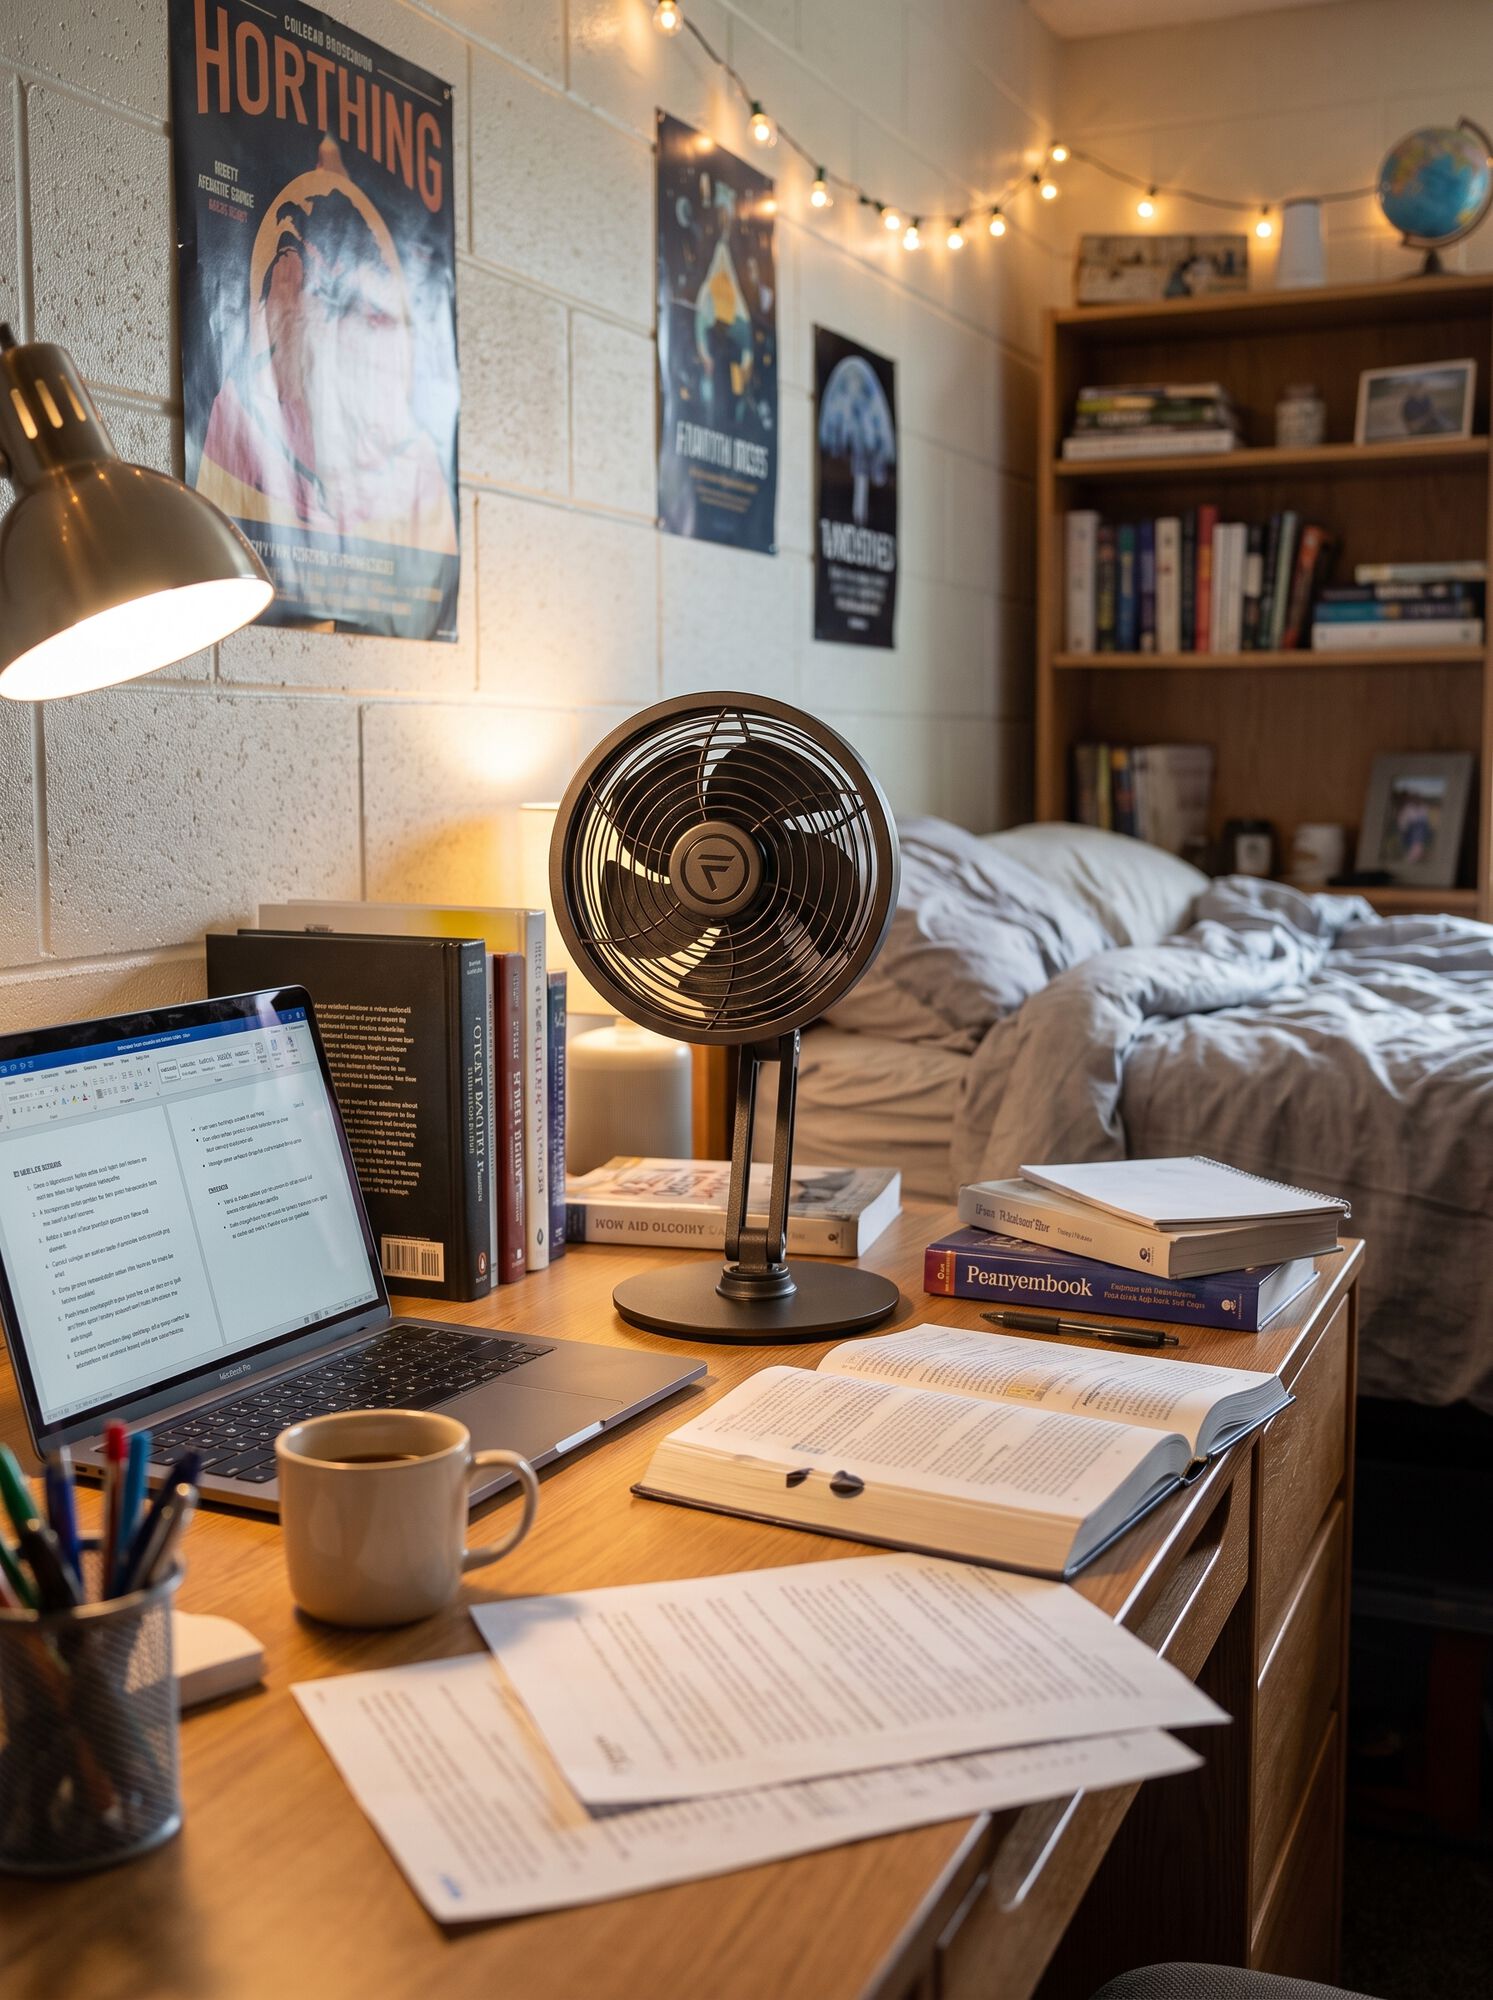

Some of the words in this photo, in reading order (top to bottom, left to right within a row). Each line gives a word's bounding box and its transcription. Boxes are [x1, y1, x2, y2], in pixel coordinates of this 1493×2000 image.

[194, 0, 442, 214] HORTHING
[627, 1220, 649, 1232] AID
[966, 1265, 1093, 1297] Peanyembook
